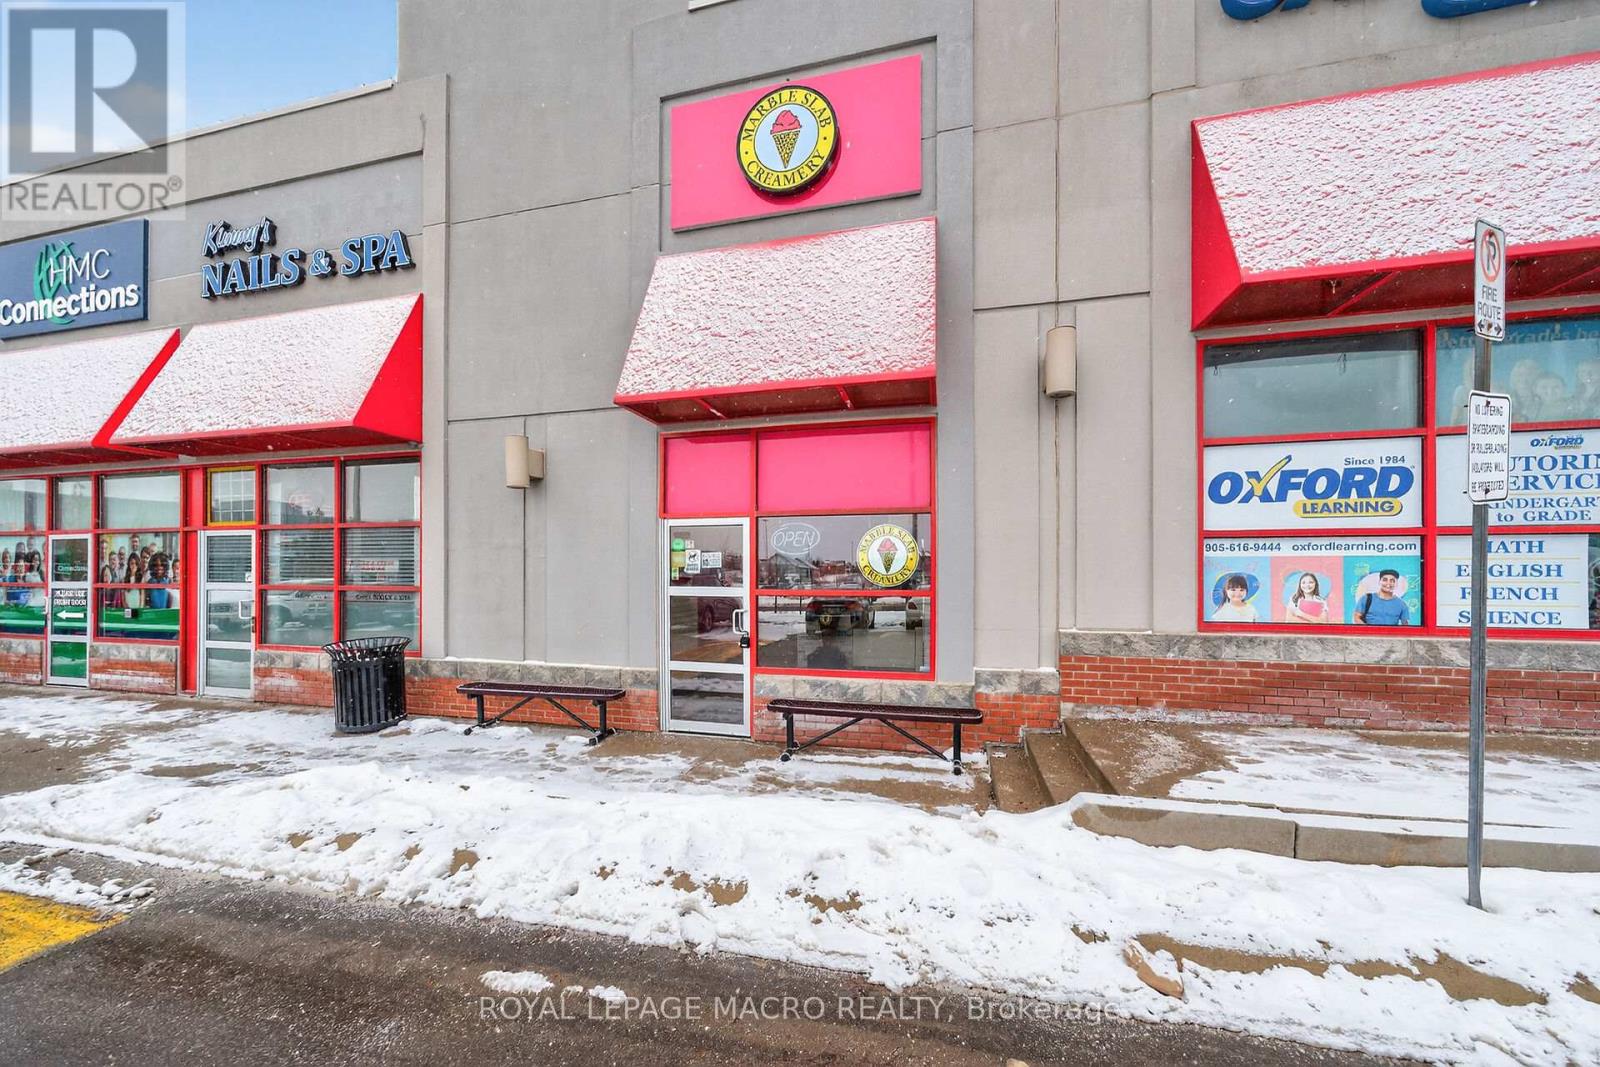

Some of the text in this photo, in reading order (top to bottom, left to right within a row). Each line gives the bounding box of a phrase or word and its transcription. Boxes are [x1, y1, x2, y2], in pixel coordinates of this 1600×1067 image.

[742, 90, 831, 142] MARBLE SLAB
[746, 149, 825, 187] CREAMERY
[49, 248, 111, 288] HMC
[201, 229, 410, 298] NAILS & SPA
[1481, 285, 1498, 303] FIRE
[0, 284, 140, 325] Connections
[1477, 301, 1502, 321] ROUTE
[1344, 455, 1406, 466] Since 1984
[1509, 453, 1600, 472] UTORI
[1207, 455, 1415, 505] OXFORD
[1509, 473, 1600, 491] ERVIC
[1302, 500, 1395, 515] LEARNING
[1489, 496, 1600, 510] INDERGAR
[1496, 510, 1592, 522] to GRADE
[773, 530, 816, 547] OPEN
[1487, 540, 1545, 554] ATH
[1292, 541, 1417, 555] oxfordlearning.com
[1455, 564, 1564, 578] EGLISH
[1460, 586, 1560, 601] FENCH
[1458, 610, 1562, 625] SIENCE
